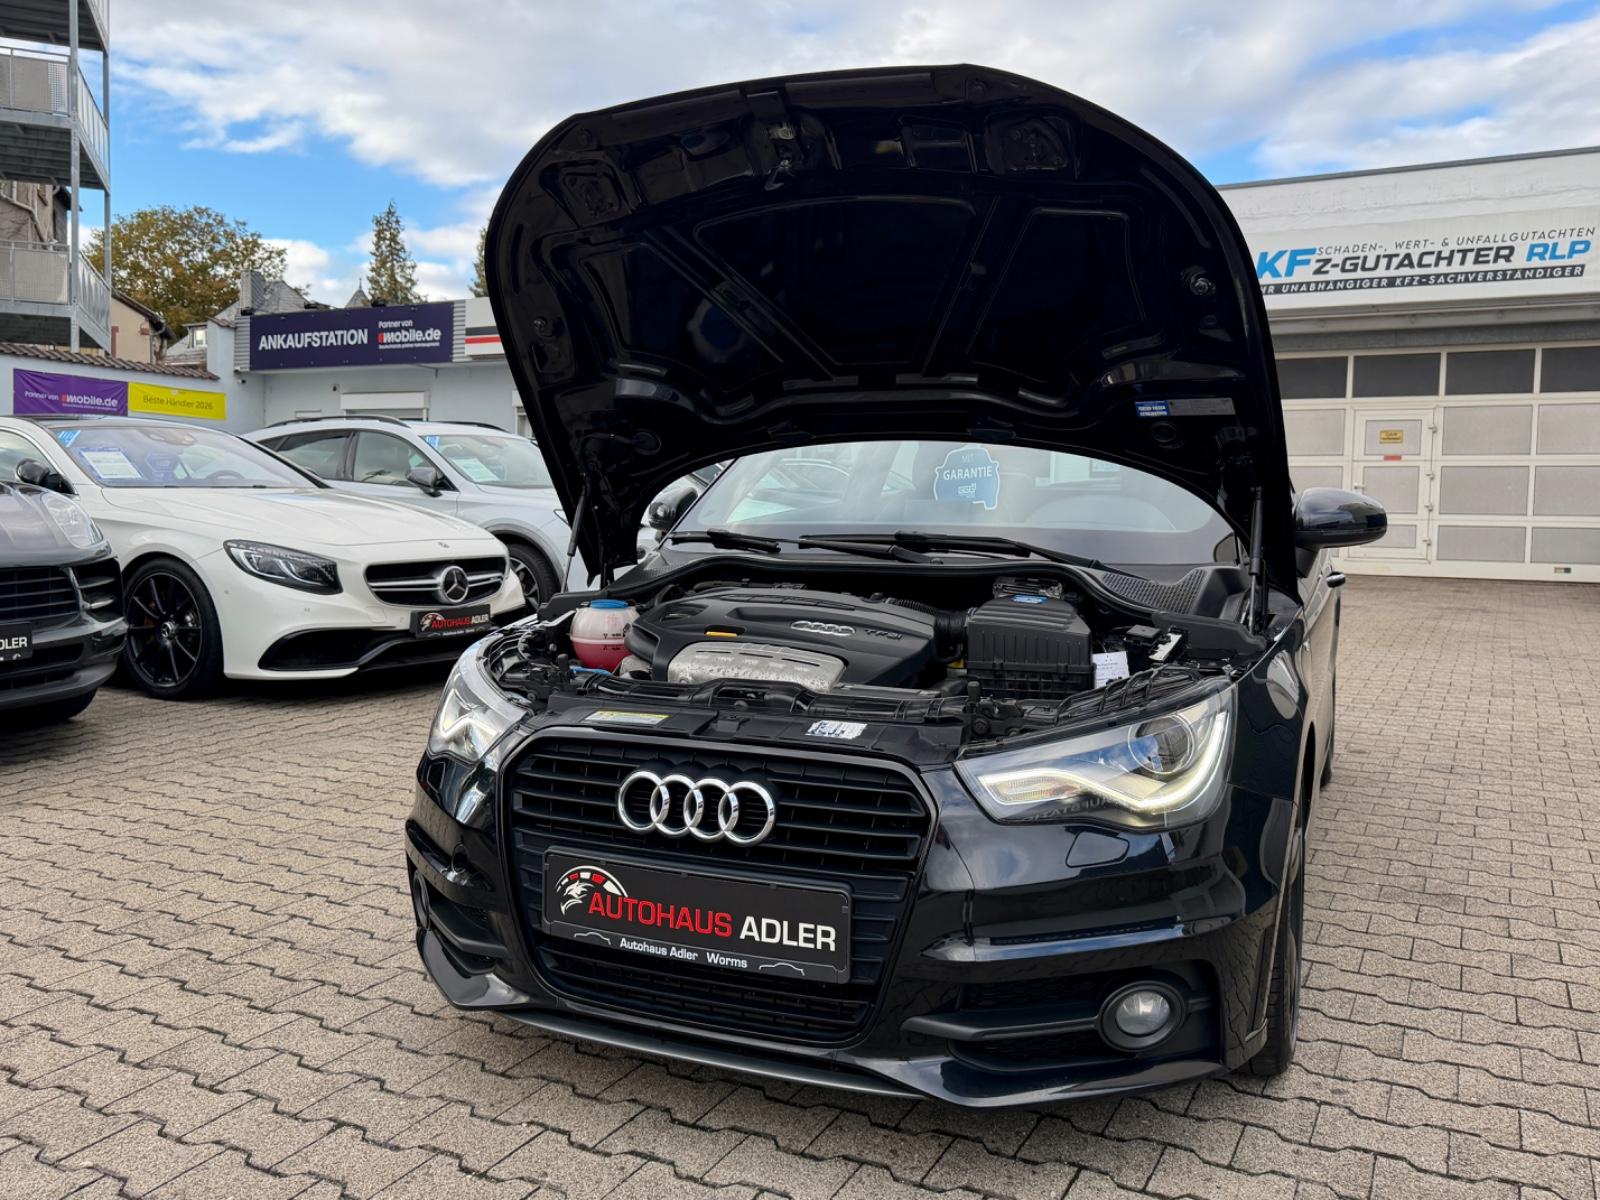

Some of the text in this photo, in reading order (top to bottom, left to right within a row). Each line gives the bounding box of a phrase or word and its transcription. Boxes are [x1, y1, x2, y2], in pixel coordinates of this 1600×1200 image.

[1395, 239, 1435, 250] WERT-
[1441, 237, 1450, 247] &
[1456, 226, 1596, 246] UNFALLGUTACHTEN
[1525, 239, 1592, 263] RLP
[1260, 266, 1584, 294] HR UNABHÄNGIGER KFZ-SACHVERSTÄNDIGER
[378, 319, 413, 328] Partner von
[258, 328, 369, 351] ANKAUFSTATION
[383, 328, 442, 343] mobile.de
[66, 393, 118, 407] mobile.de
[143, 395, 214, 410] Beste Händler 2026
[943, 465, 993, 481] GARANTIE
[431, 614, 489, 629] AUTOHAUS ADLER
[0, 636, 28, 650] DLER
[588, 891, 837, 952] AUTOHAUS ADLER
[620, 936, 748, 969] Autohaus Adler Worms
